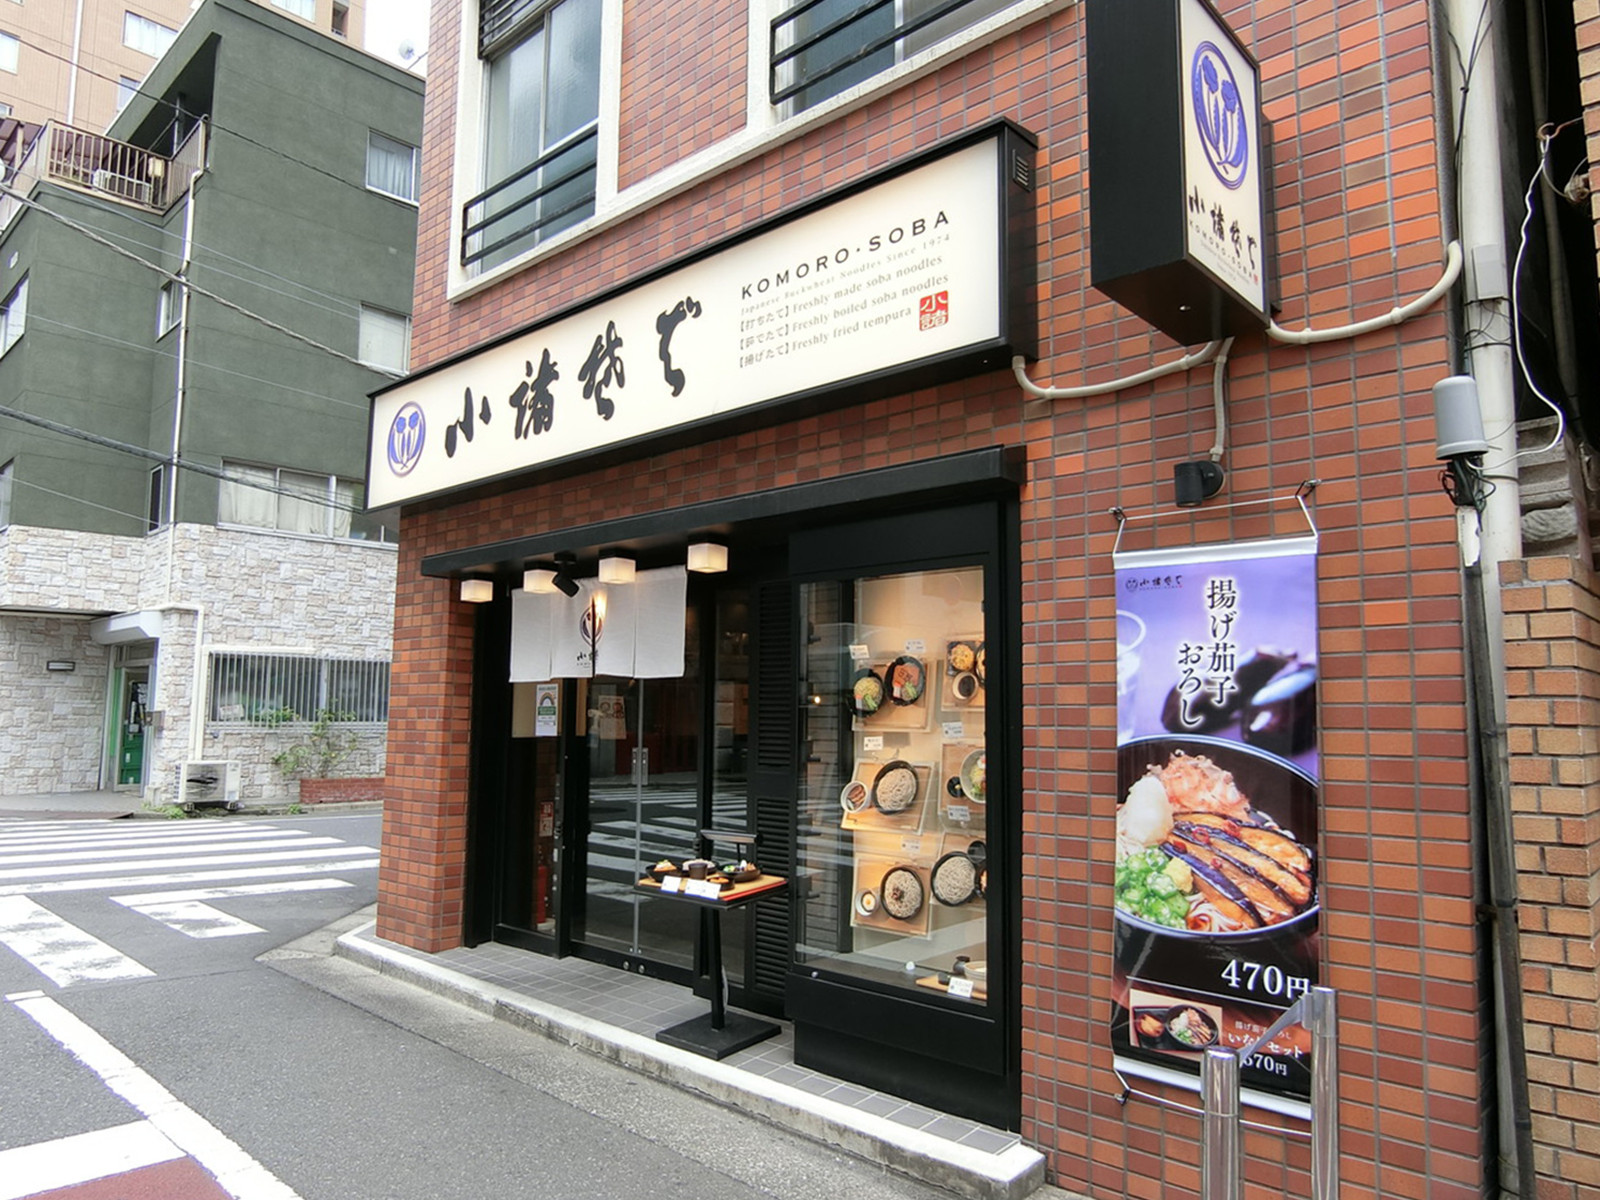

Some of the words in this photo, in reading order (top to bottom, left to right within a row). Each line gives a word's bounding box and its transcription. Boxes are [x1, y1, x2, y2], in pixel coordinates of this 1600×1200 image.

[886, 246, 916, 263] Since
[922, 233, 951, 250] 1974
[792, 294, 830, 314] Freshly
[834, 282, 863, 300] made
[866, 273, 892, 290] soba
[896, 255, 943, 279] noodles
[792, 312, 830, 333] Freshly
[833, 300, 868, 318] boiled
[871, 289, 898, 307] soba
[901, 273, 950, 298] noodles
[792, 331, 830, 352] Freshly
[833, 322, 860, 338] fried
[863, 306, 912, 331] tempura
[1206, 579, 1237, 705] 揚げ茄子
[1177, 643, 1204, 726] おろし
[1221, 959, 1310, 999] 470円
